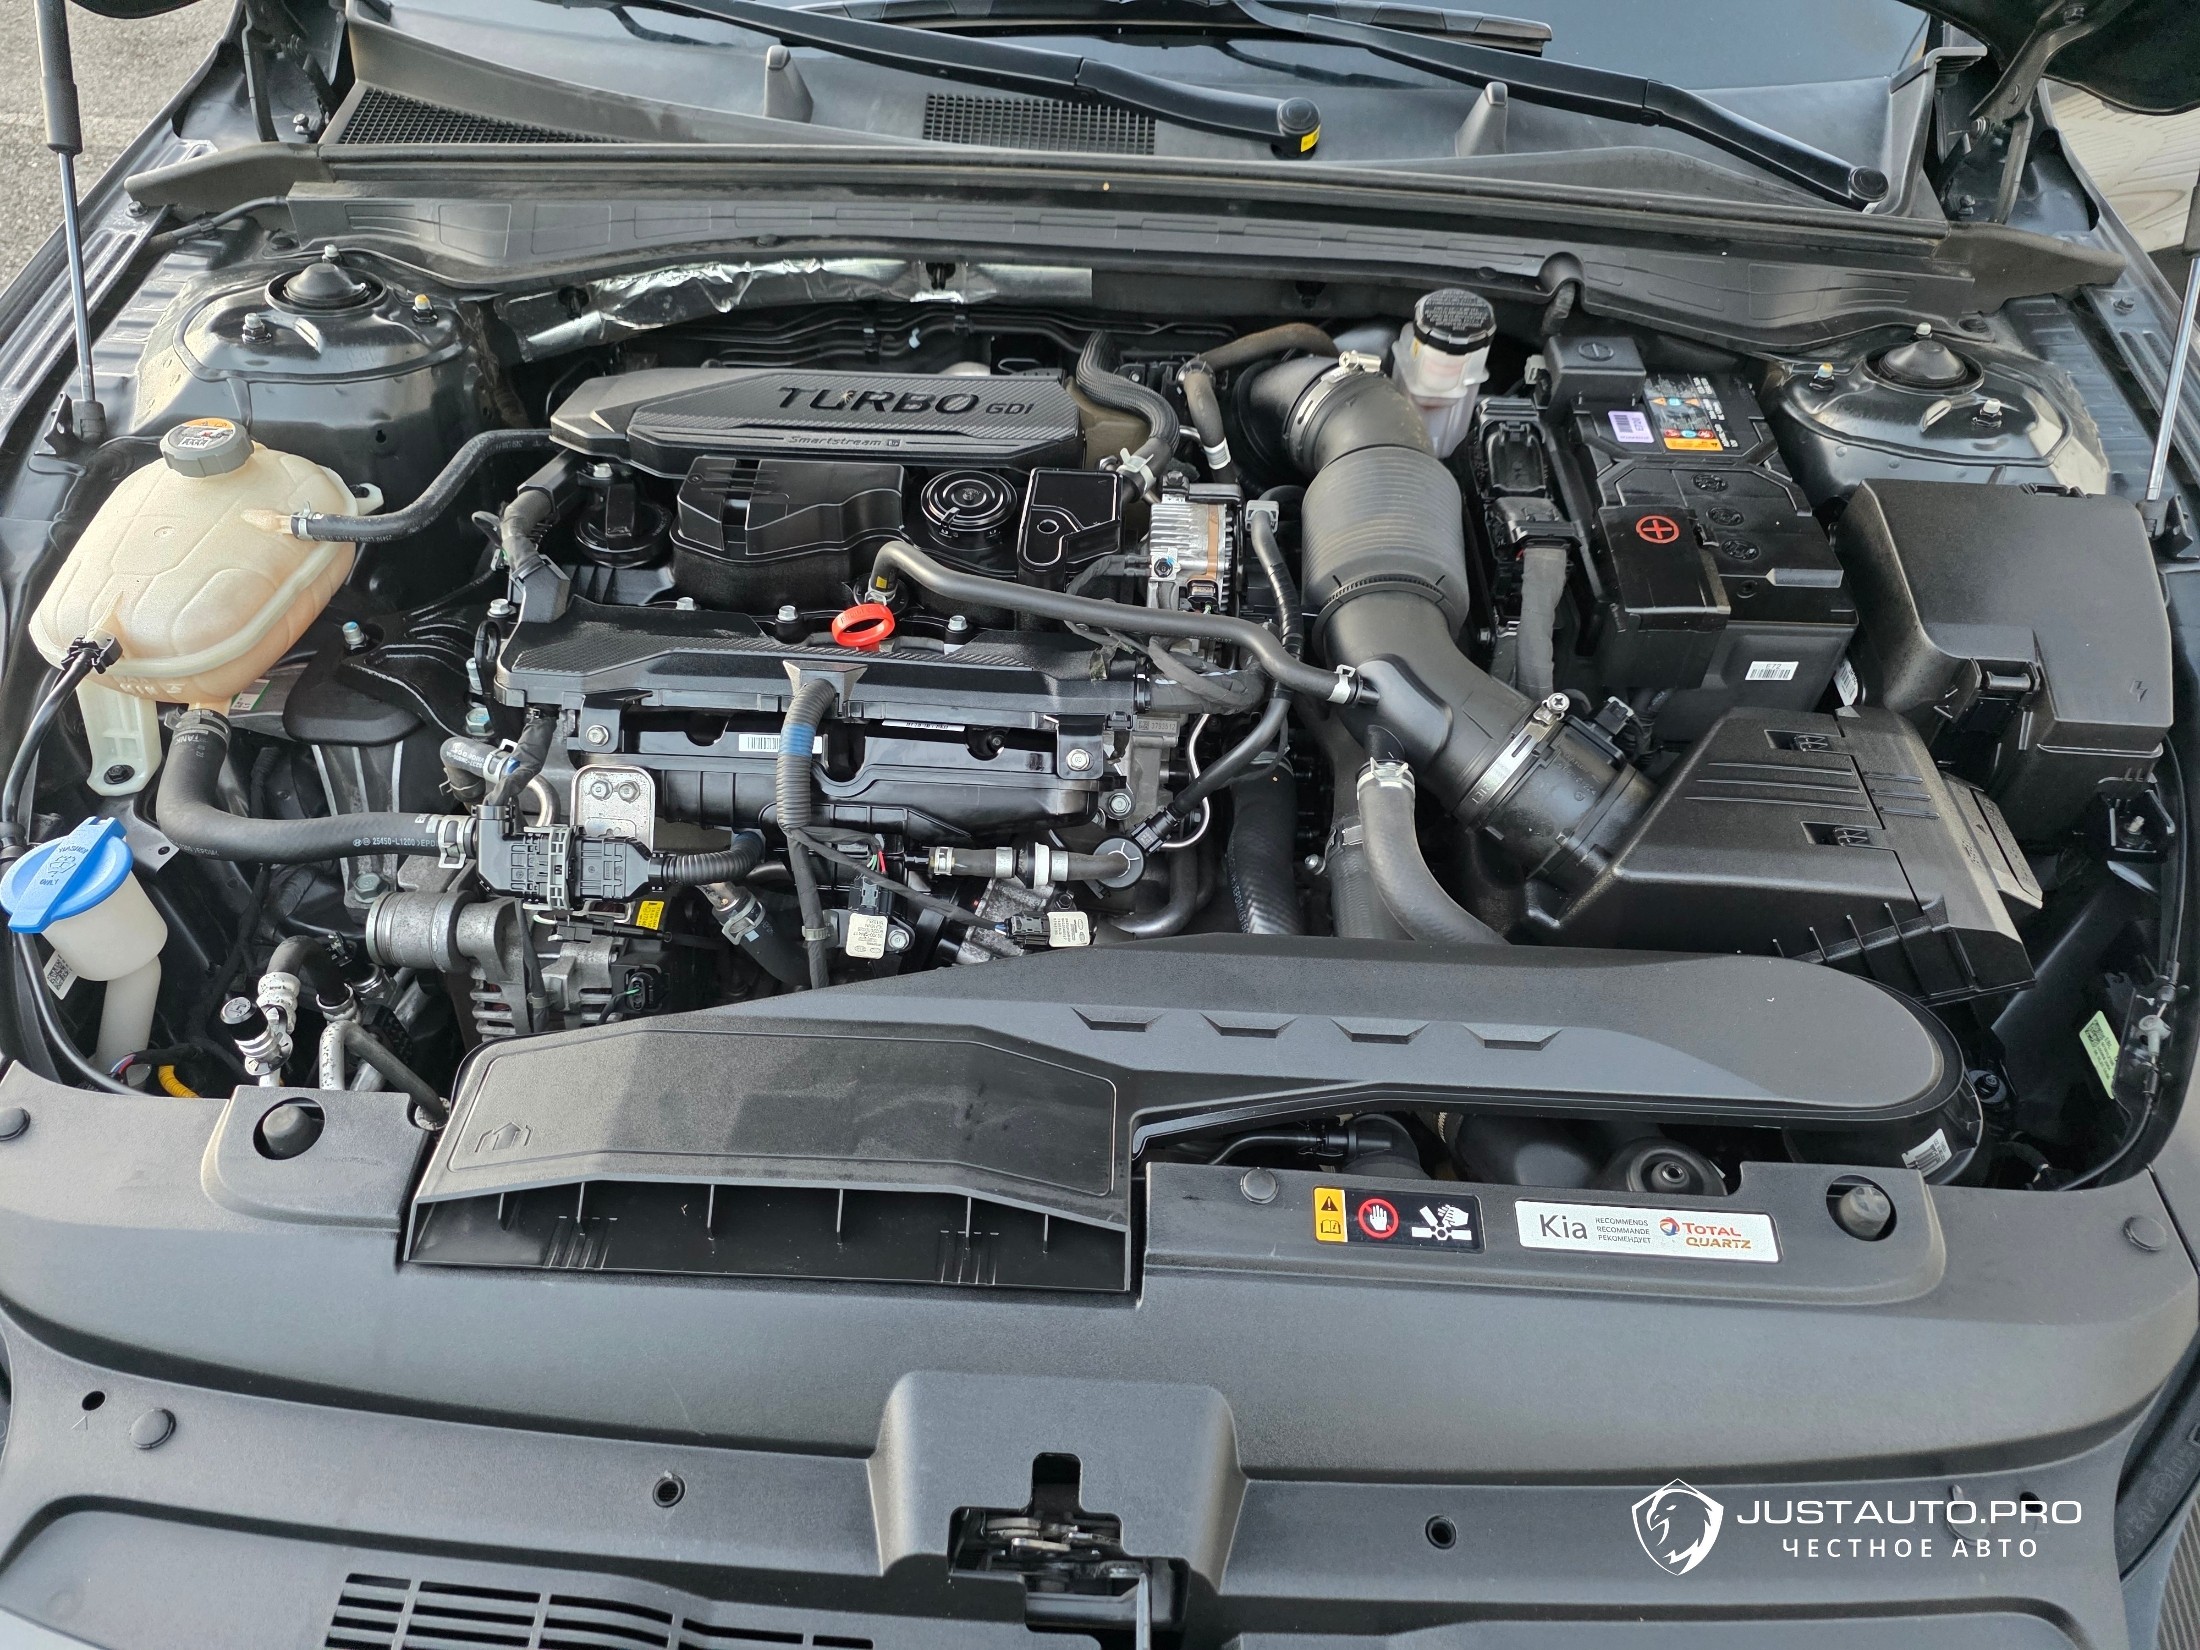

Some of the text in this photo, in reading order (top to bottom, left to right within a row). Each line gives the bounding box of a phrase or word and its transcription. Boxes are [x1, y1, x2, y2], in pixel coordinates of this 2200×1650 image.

[779, 387, 1034, 415] TURBO GDI
[788, 436, 882, 446] Smartstream
[174, 733, 200, 746] TANK
[39, 878, 60, 886] ONLY
[1539, 1213, 1588, 1240] Kia
[1595, 1217, 1649, 1227] RECOMMENDS
[1596, 1226, 1650, 1235] RECOMMANDE
[1682, 1222, 1742, 1237] TOTAL
[1598, 1234, 1651, 1244] РЕКОМЕНДУЕТ
[1685, 1236, 1752, 1249] QUARTZ
